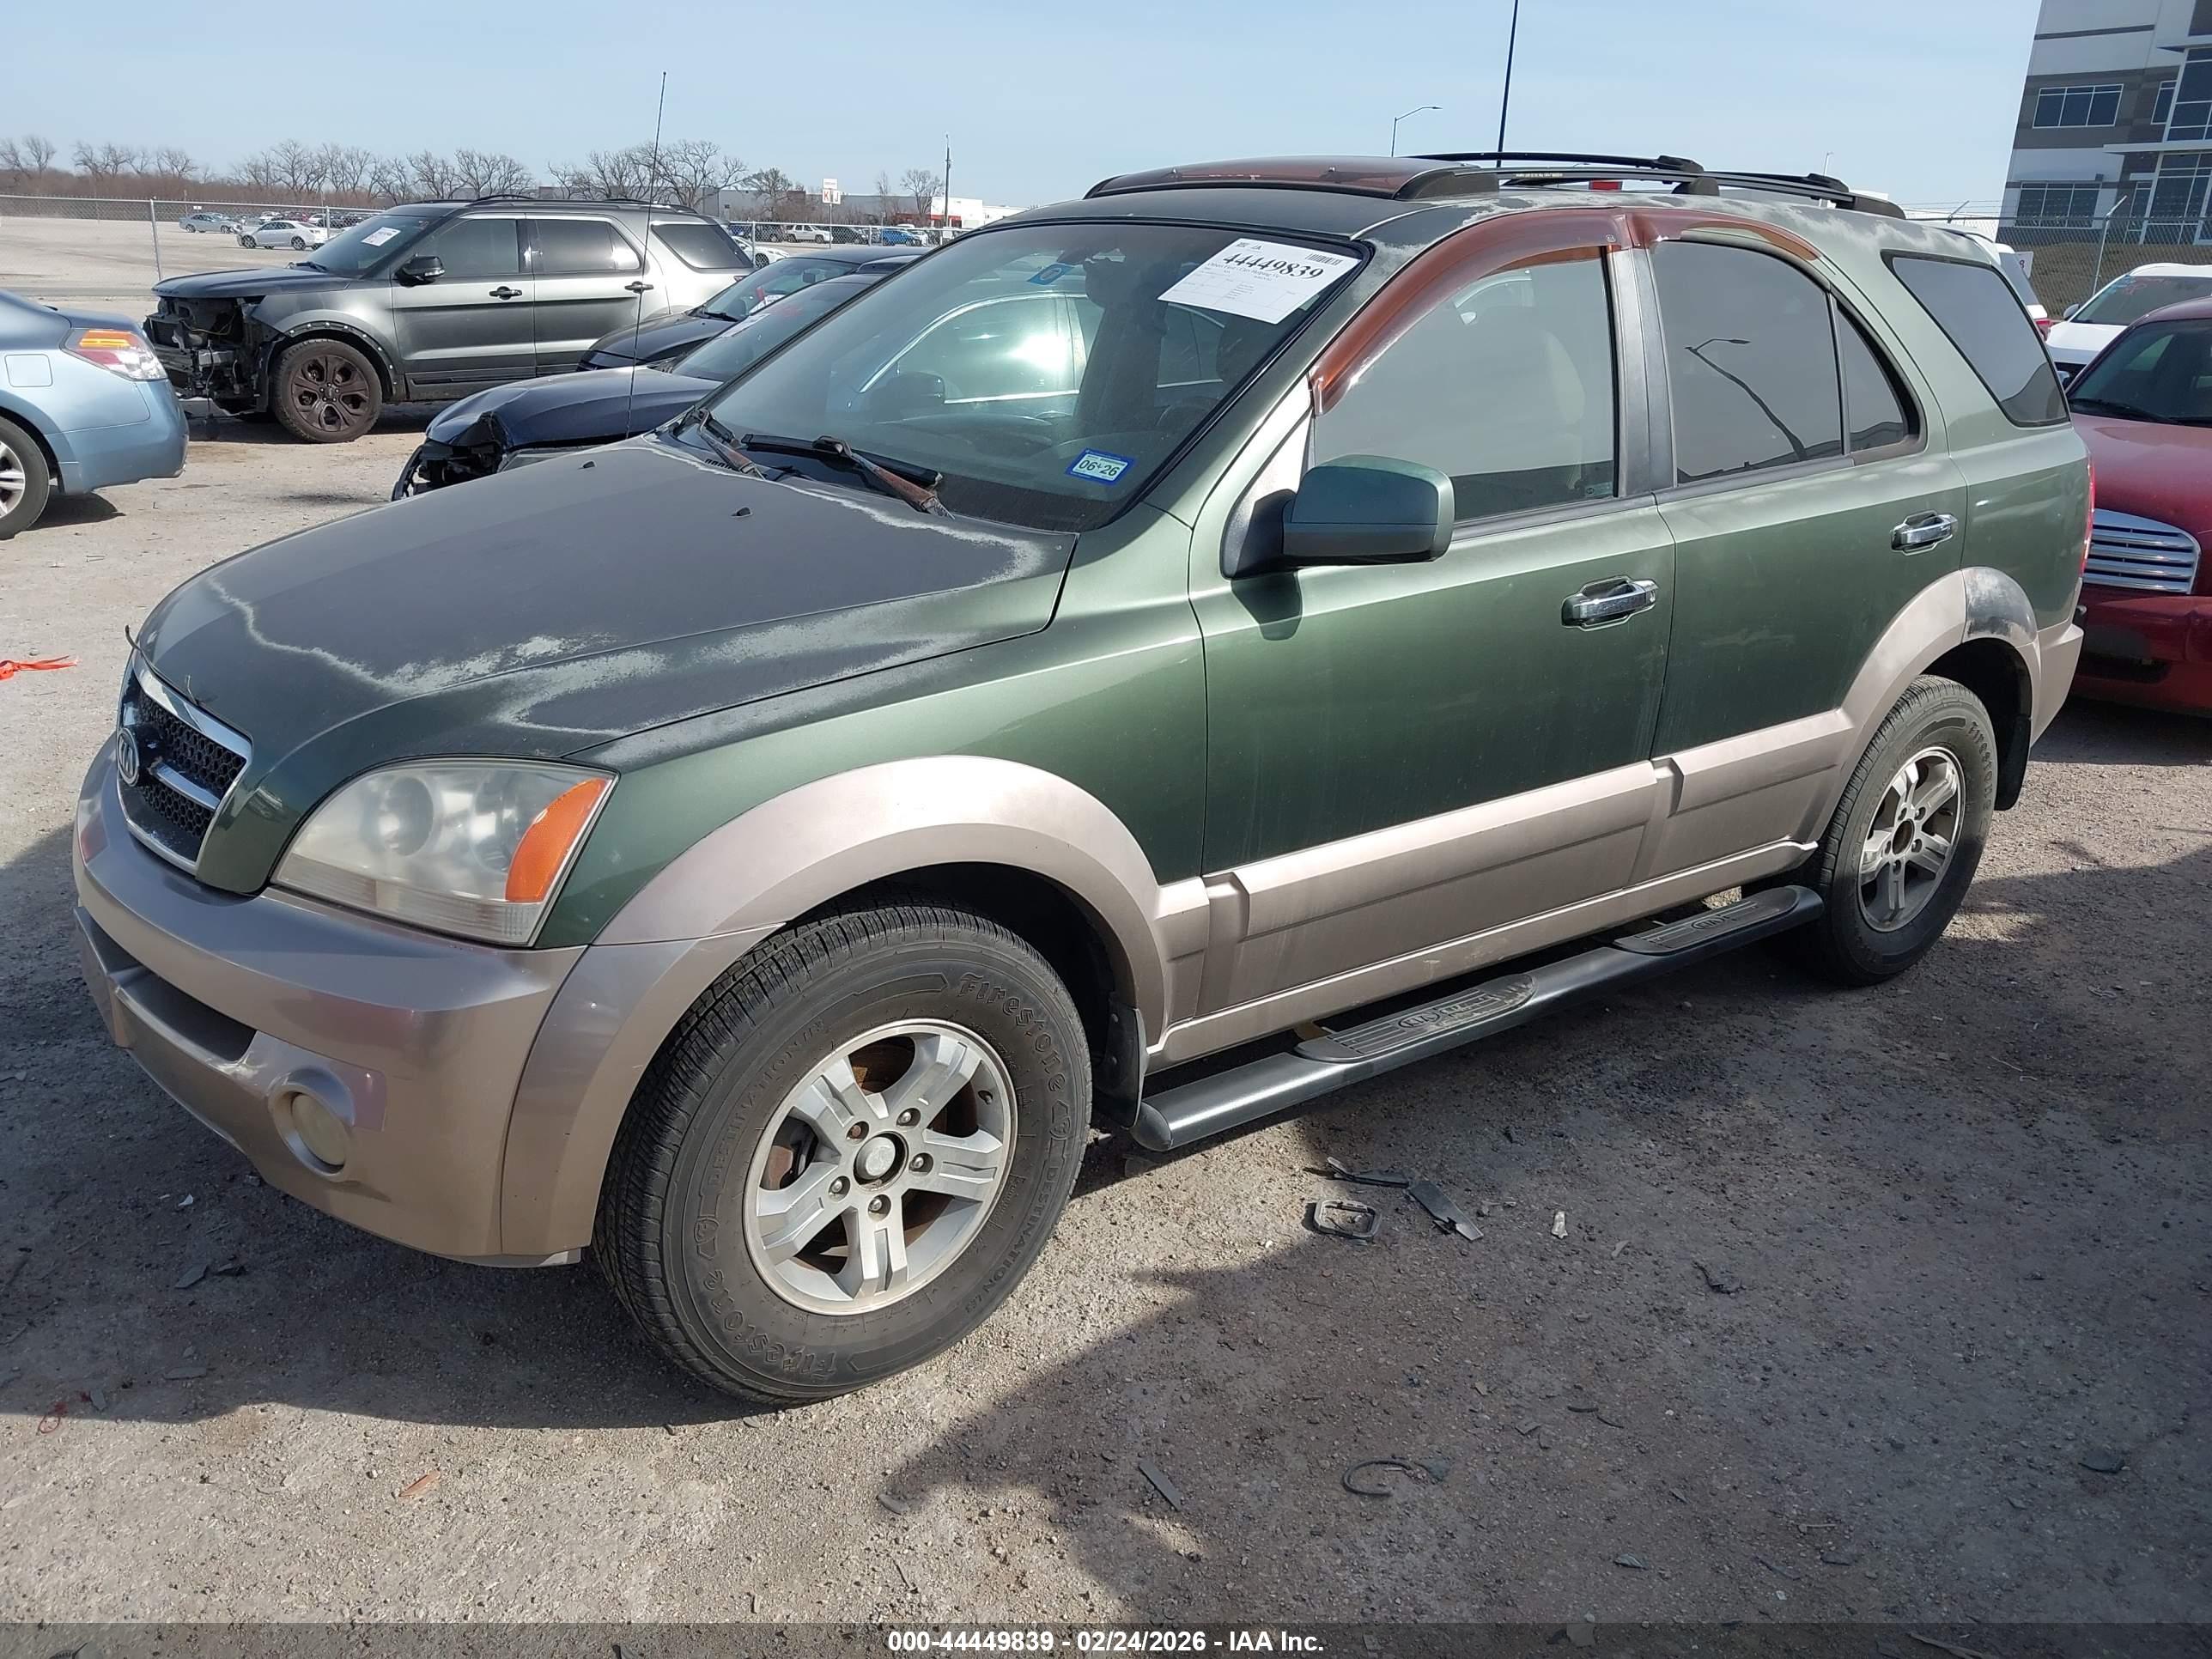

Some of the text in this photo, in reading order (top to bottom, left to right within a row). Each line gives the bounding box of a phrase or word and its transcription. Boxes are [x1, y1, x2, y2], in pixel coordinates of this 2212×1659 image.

[823, 190, 830, 201] K
[1223, 252, 1324, 279] 44449839
[1079, 459, 1098, 471] 06
[1099, 465, 1120, 477] 26
[957, 971, 1066, 1093] Firestone
[1402, 1012, 1437, 1028] KIA
[982, 1166, 1060, 1294] DESTINATION
[704, 1269, 838, 1379] Firestone
